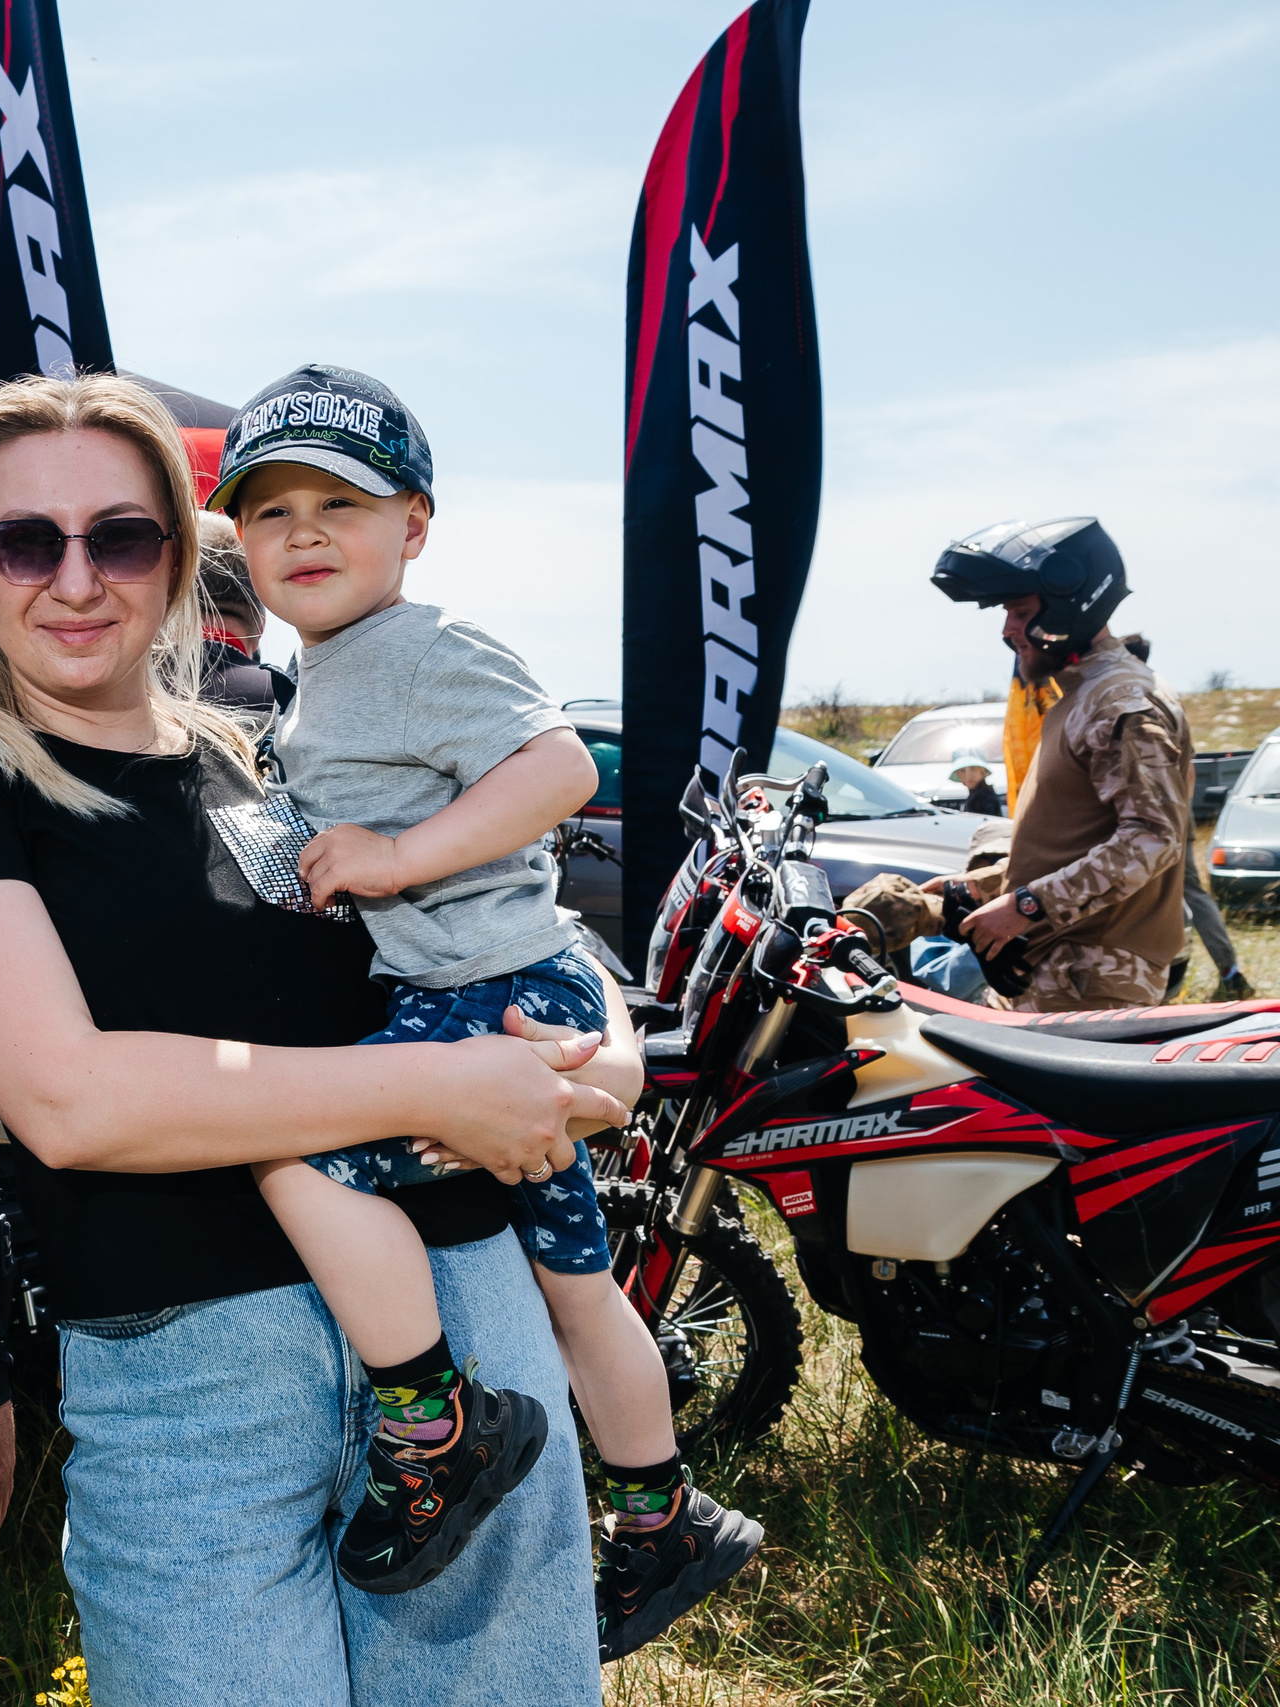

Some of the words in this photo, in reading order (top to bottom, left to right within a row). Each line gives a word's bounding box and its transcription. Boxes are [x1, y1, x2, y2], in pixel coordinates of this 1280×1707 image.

[235, 391, 384, 453] JAWSOME
[722, 1109, 910, 1158] SHARMAX
[784, 1193, 811, 1205] MOTUL
[786, 1203, 814, 1216] KENDA
[1244, 1201, 1271, 1217] AIR
[1141, 1388, 1256, 1441] SHARMAX
